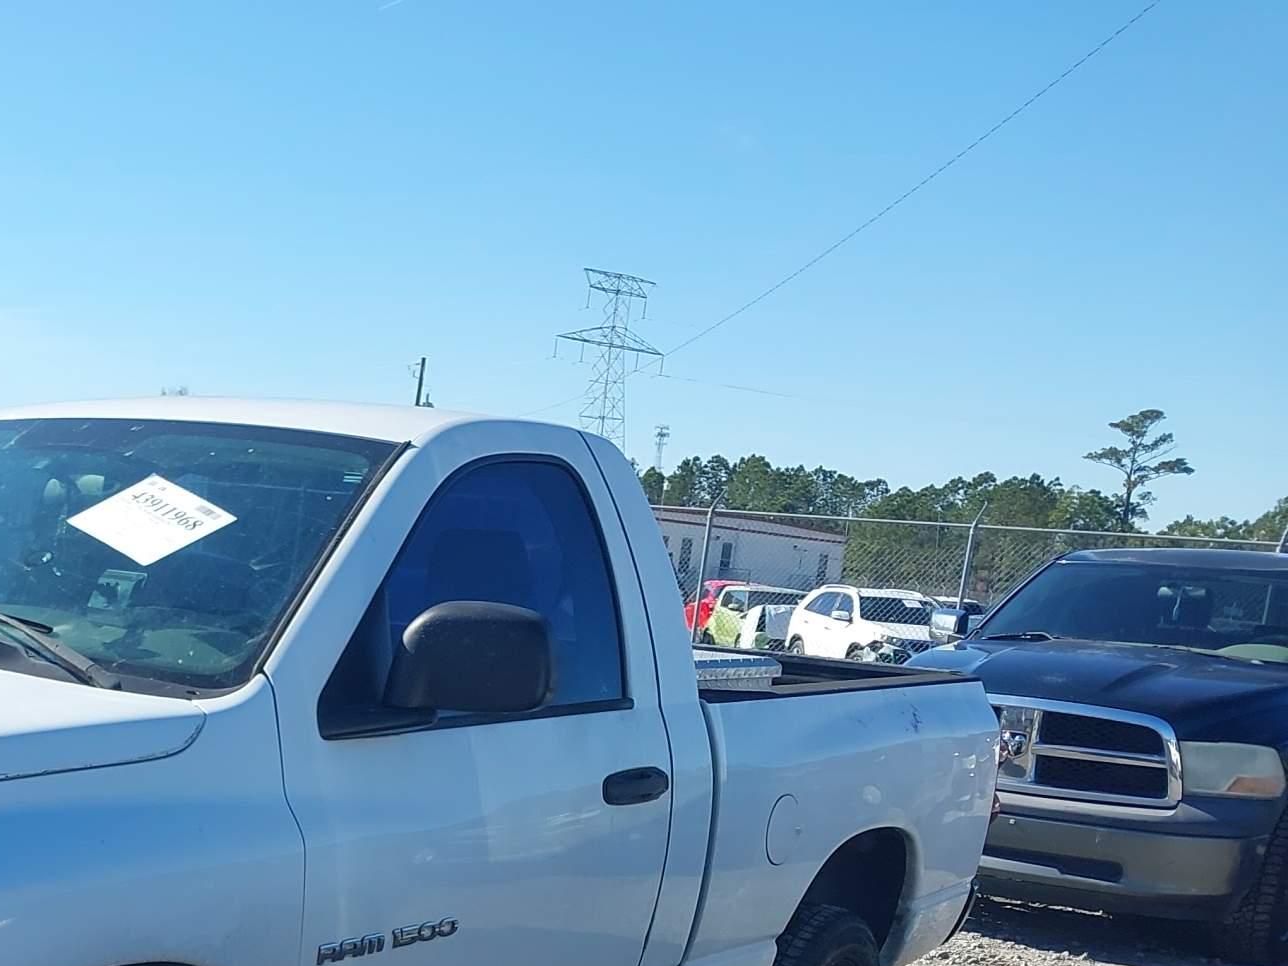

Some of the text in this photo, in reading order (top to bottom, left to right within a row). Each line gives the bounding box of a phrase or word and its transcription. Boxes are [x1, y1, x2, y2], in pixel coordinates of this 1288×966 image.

[131, 491, 205, 531] 43911968
[316, 916, 460, 966] RAM 1500
